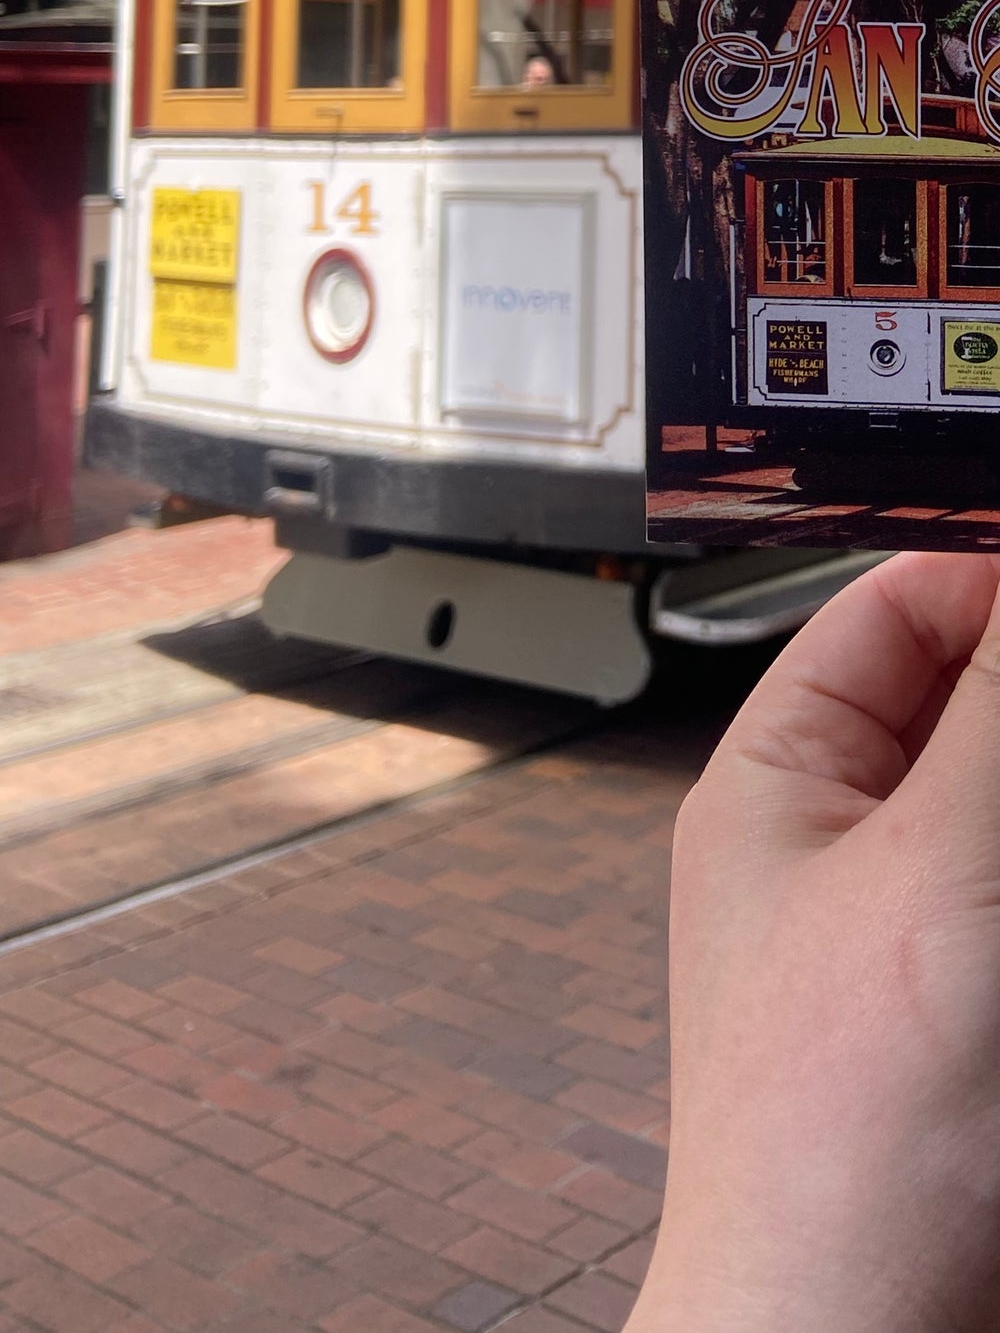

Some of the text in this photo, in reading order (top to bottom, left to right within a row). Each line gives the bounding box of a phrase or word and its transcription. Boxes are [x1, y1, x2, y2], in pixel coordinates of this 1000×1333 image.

[303, 179, 382, 236] 14
[875, 311, 898, 330] 5
[769, 325, 823, 335] POWELL
[769, 340, 825, 350] MARKET
[799, 358, 825, 369] BEACH
